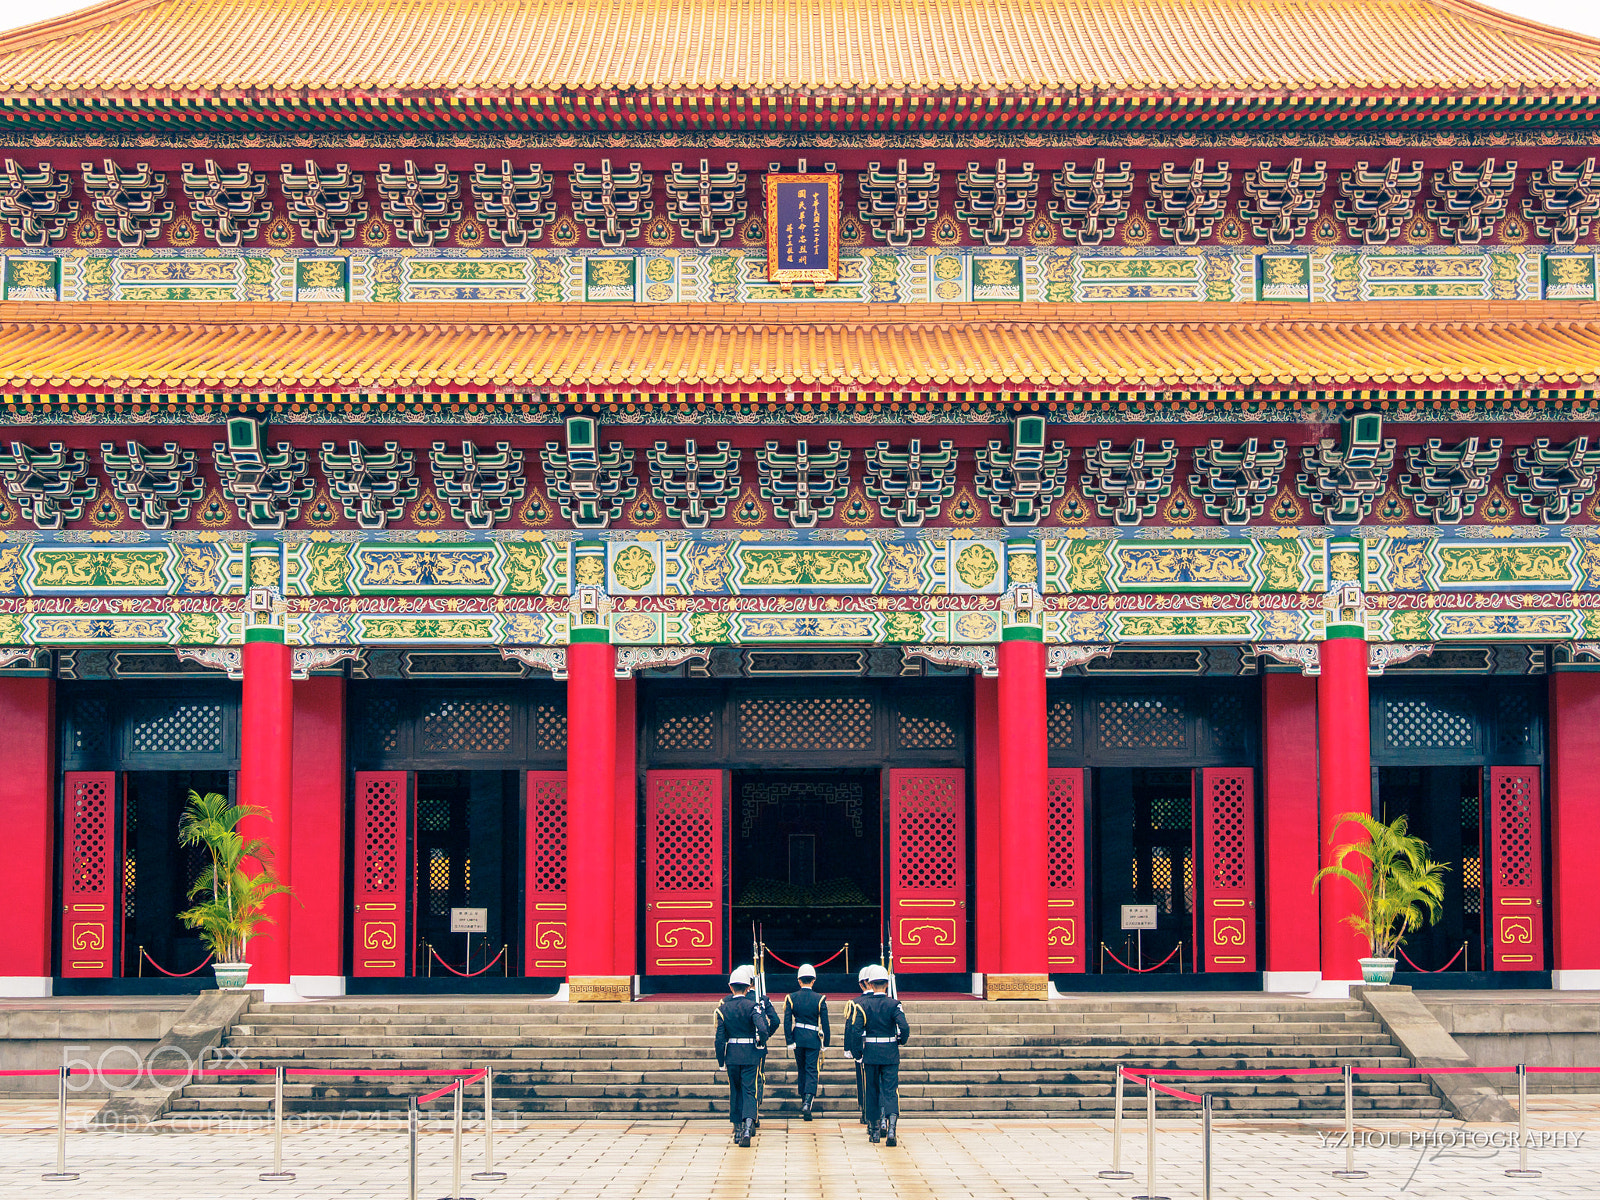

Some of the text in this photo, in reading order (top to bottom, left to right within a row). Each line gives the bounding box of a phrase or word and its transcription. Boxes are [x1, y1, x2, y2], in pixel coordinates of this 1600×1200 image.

[797, 189, 807, 265] 國民革命忠烈祠
